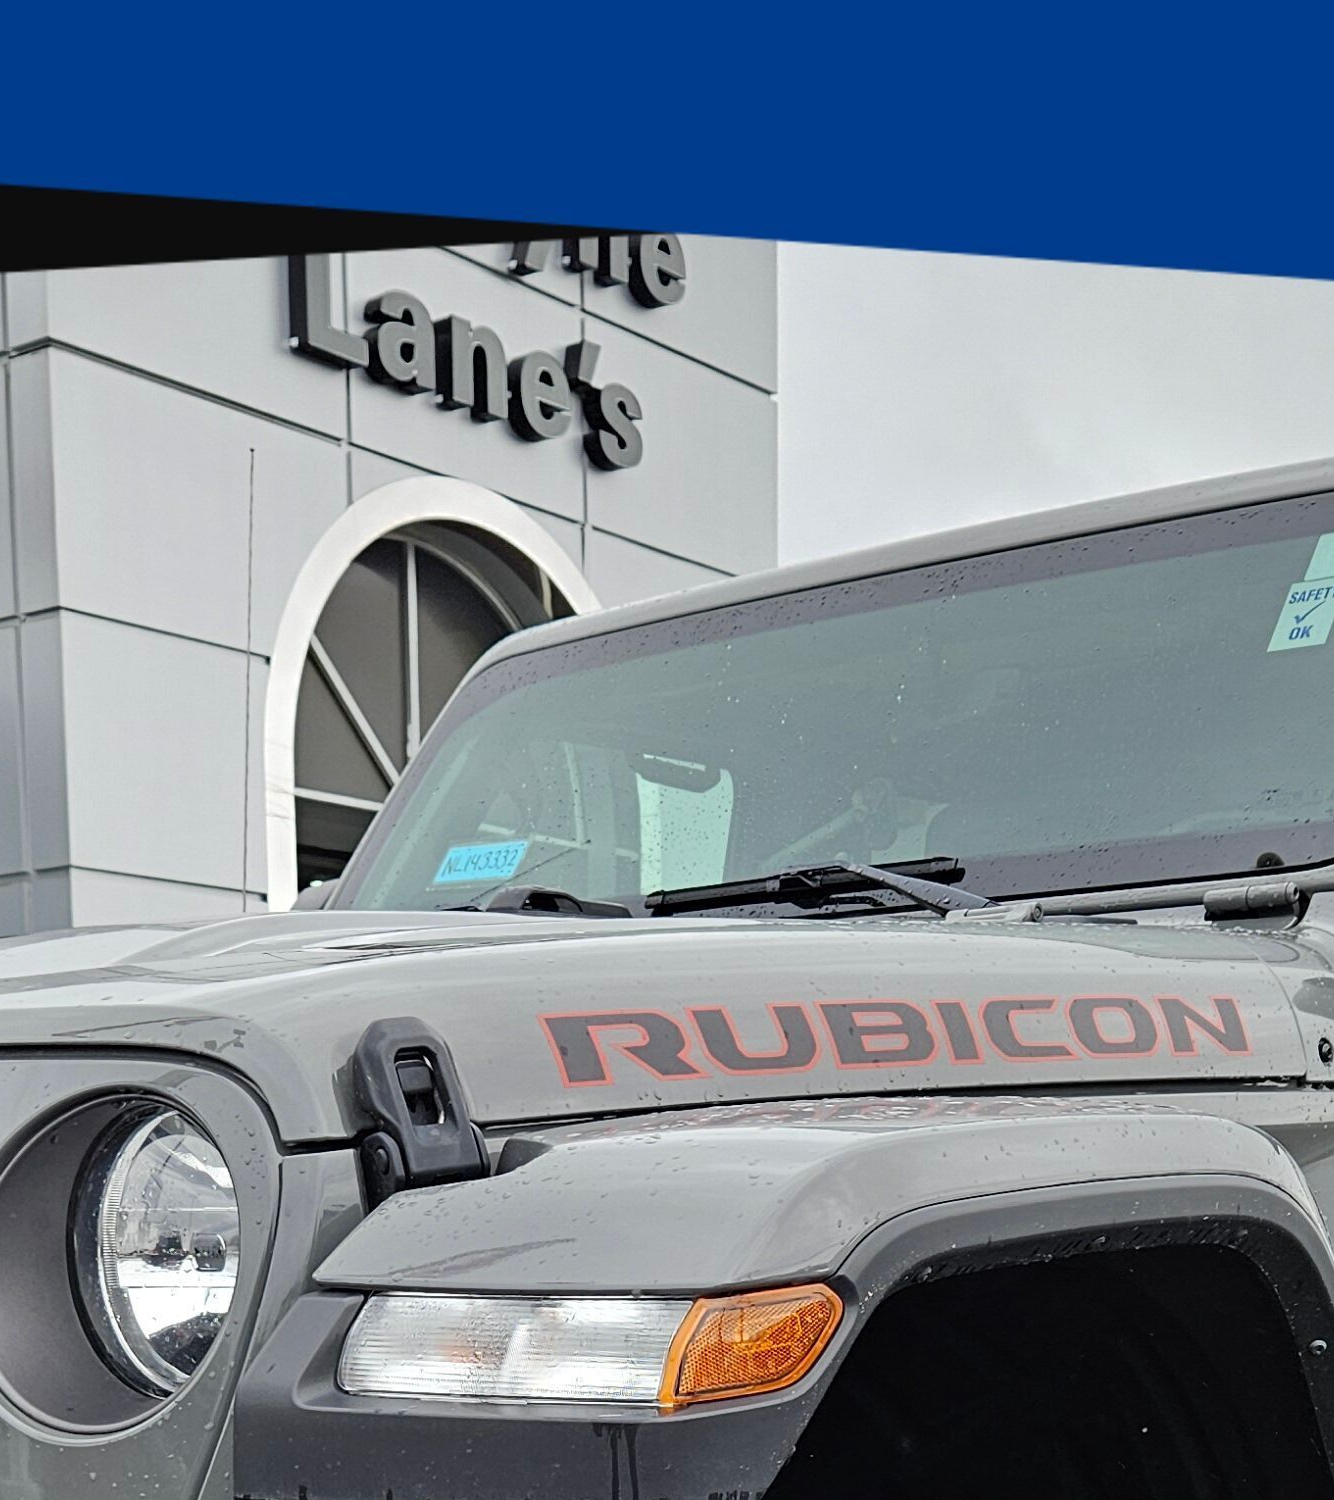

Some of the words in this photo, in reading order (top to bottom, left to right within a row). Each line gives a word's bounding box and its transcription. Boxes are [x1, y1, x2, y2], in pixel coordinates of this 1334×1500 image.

[289, 254, 644, 471] Lane's
[1288, 625, 1314, 641] OK
[538, 995, 1253, 1089] RUBICON
